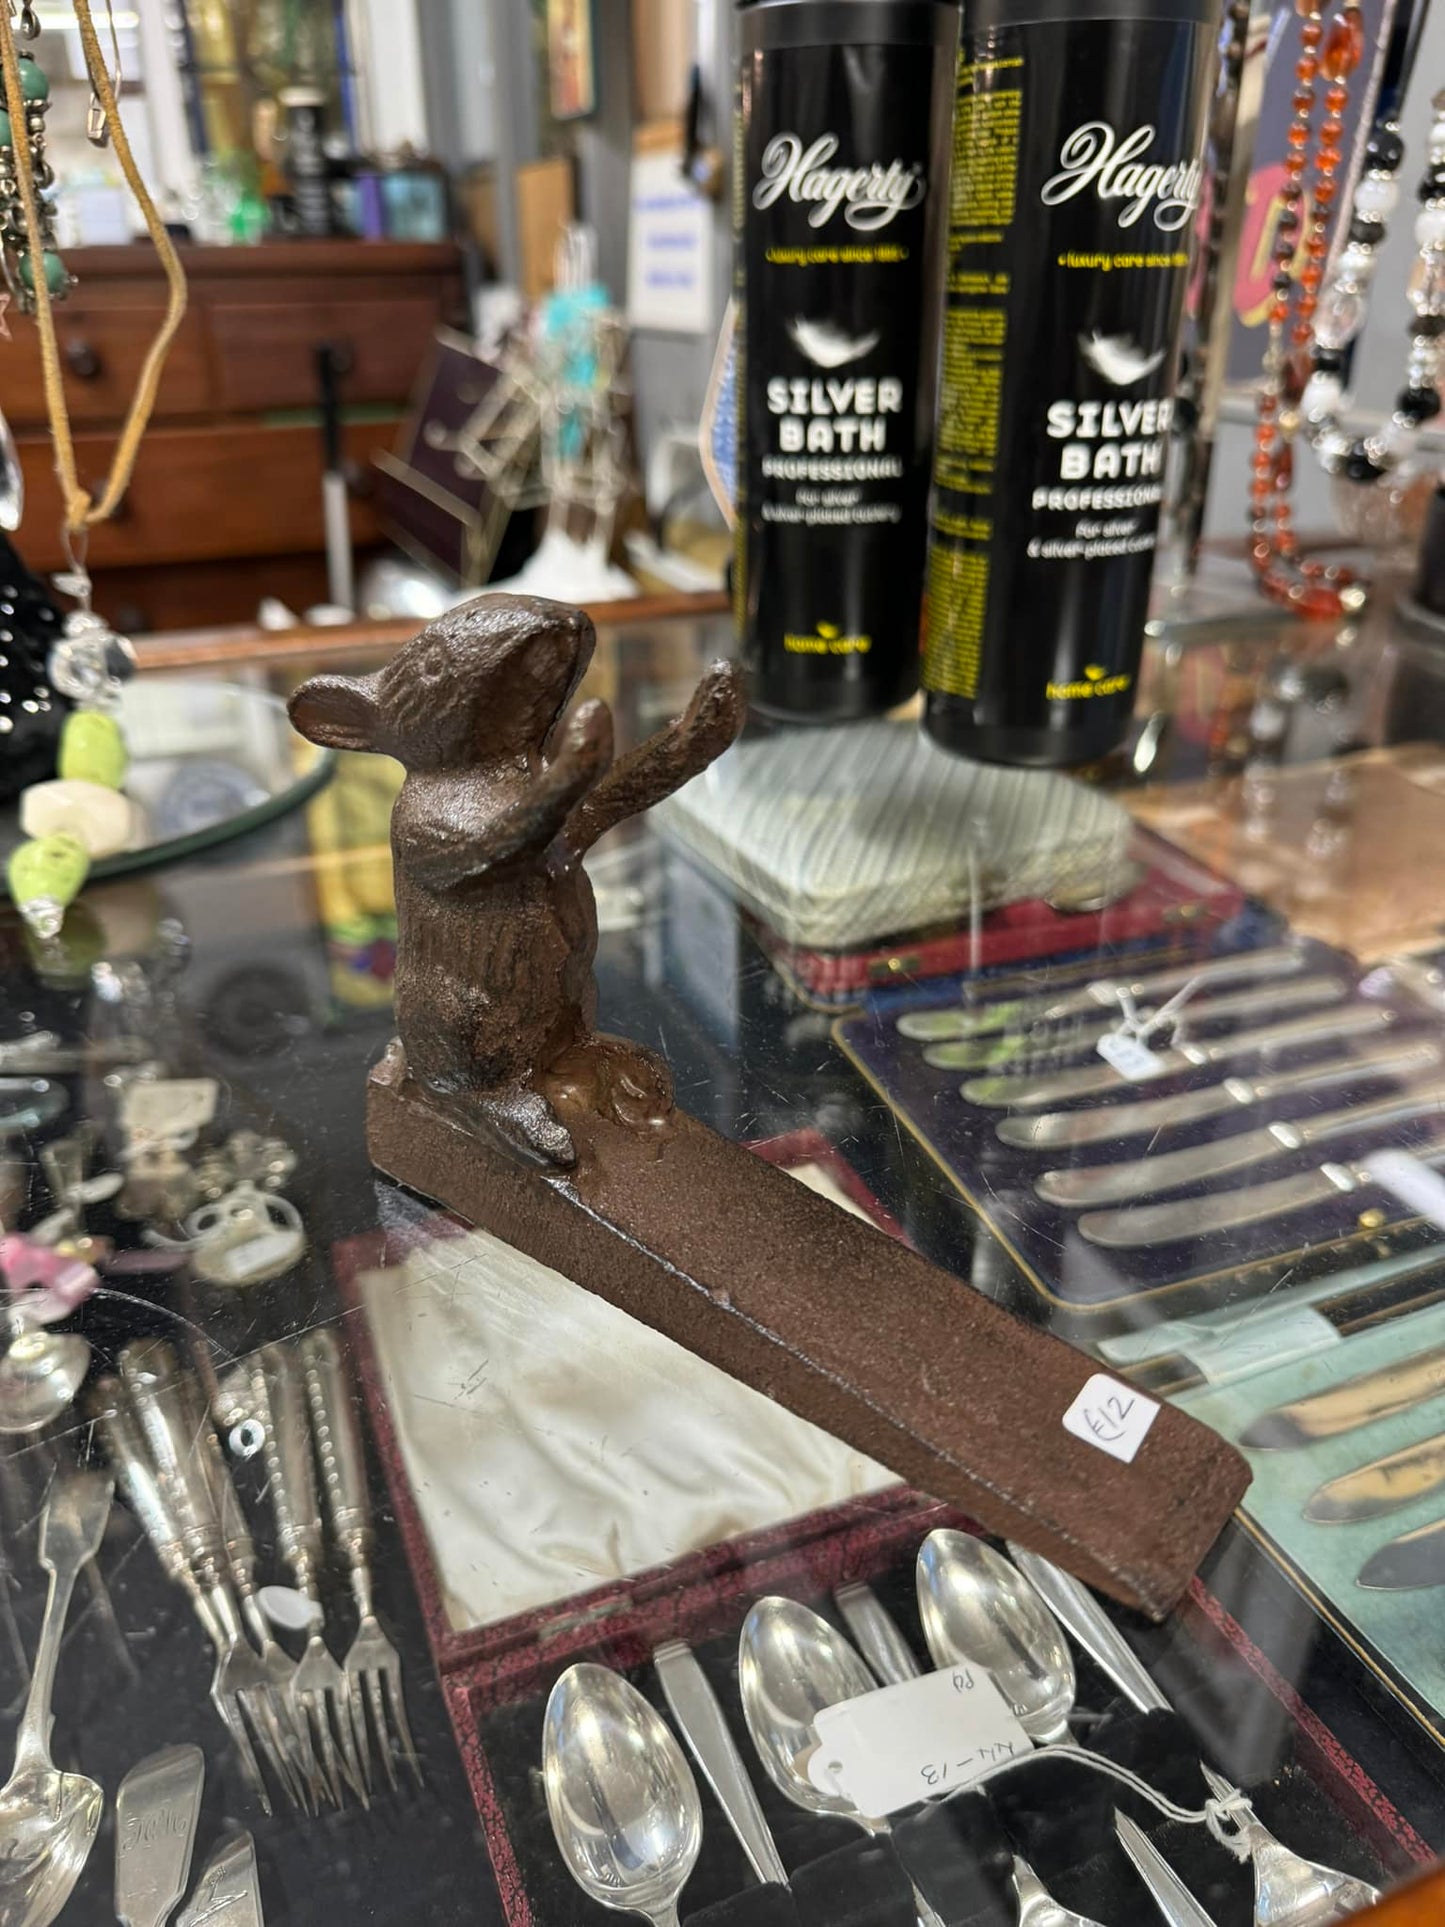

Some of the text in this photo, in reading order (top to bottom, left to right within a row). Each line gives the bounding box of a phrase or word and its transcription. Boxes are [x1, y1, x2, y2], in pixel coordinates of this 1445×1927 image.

[753, 131, 926, 231] Hagerty
[1041, 120, 1202, 231] Hagerty
[1067, 250, 1112, 272] luxury
[1113, 252, 1144, 269] care
[767, 377, 903, 415] SILVER
[779, 416, 887, 454] BATH
[1046, 399, 1175, 438] SILVER
[762, 454, 903, 480] PROFESSIONAL
[1060, 441, 1162, 479] BATH
[784, 633, 872, 655] home care
[1046, 675, 1130, 700] home care
[1083, 1396, 1136, 1442] £12
